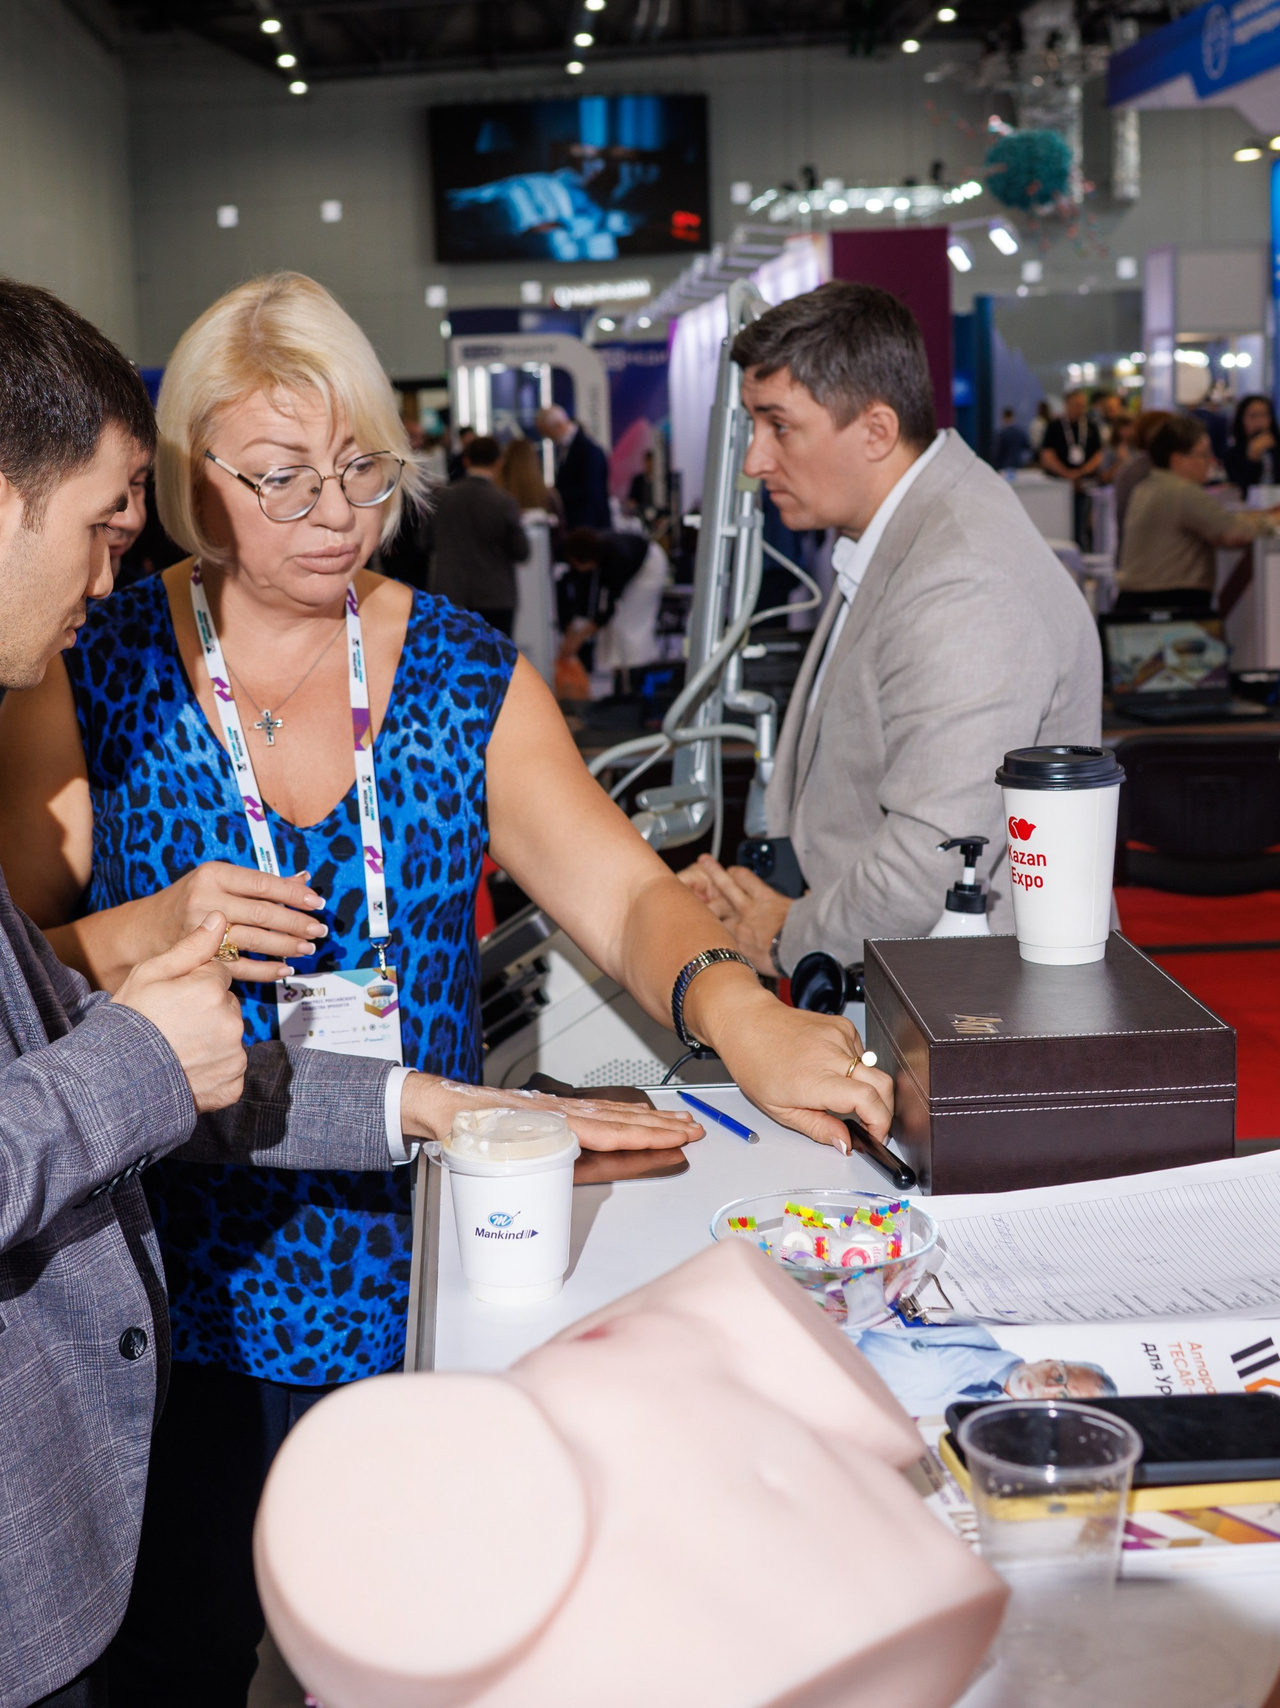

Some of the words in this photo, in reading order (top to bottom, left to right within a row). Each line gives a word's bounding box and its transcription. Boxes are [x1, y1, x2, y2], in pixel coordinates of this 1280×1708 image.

[1011, 866, 1044, 892] Expo
[474, 1227, 525, 1240] Mankind
[1141, 1342, 1163, 1371] для
